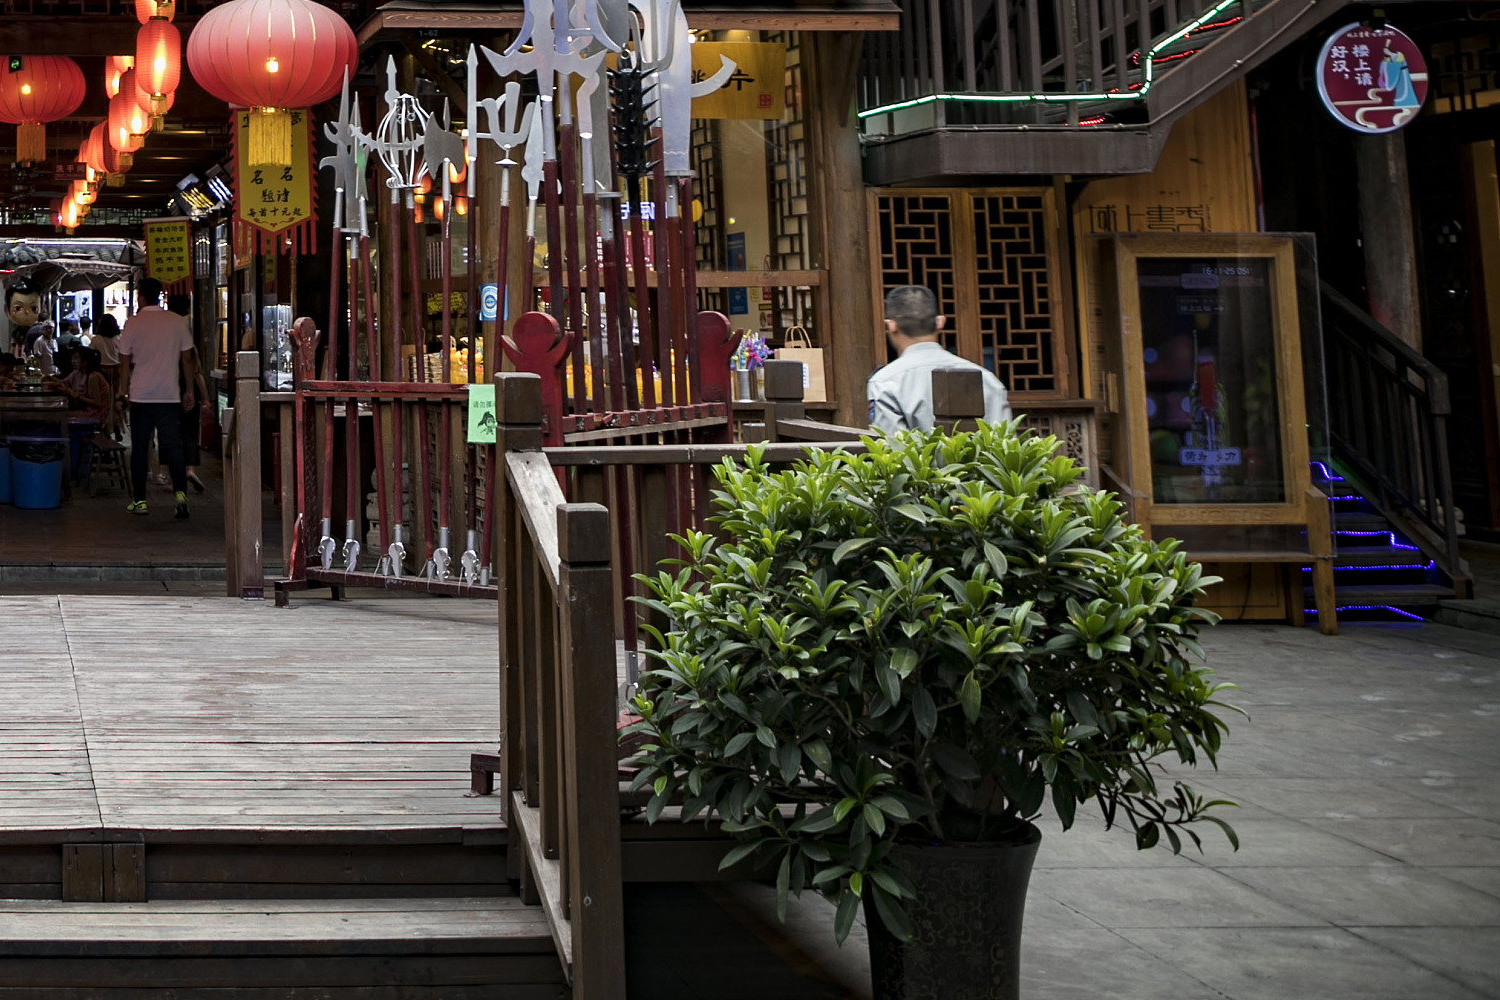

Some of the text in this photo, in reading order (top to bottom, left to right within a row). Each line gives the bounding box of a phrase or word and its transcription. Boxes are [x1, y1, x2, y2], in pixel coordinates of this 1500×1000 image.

[247, 207, 302, 217] 每首十元起
